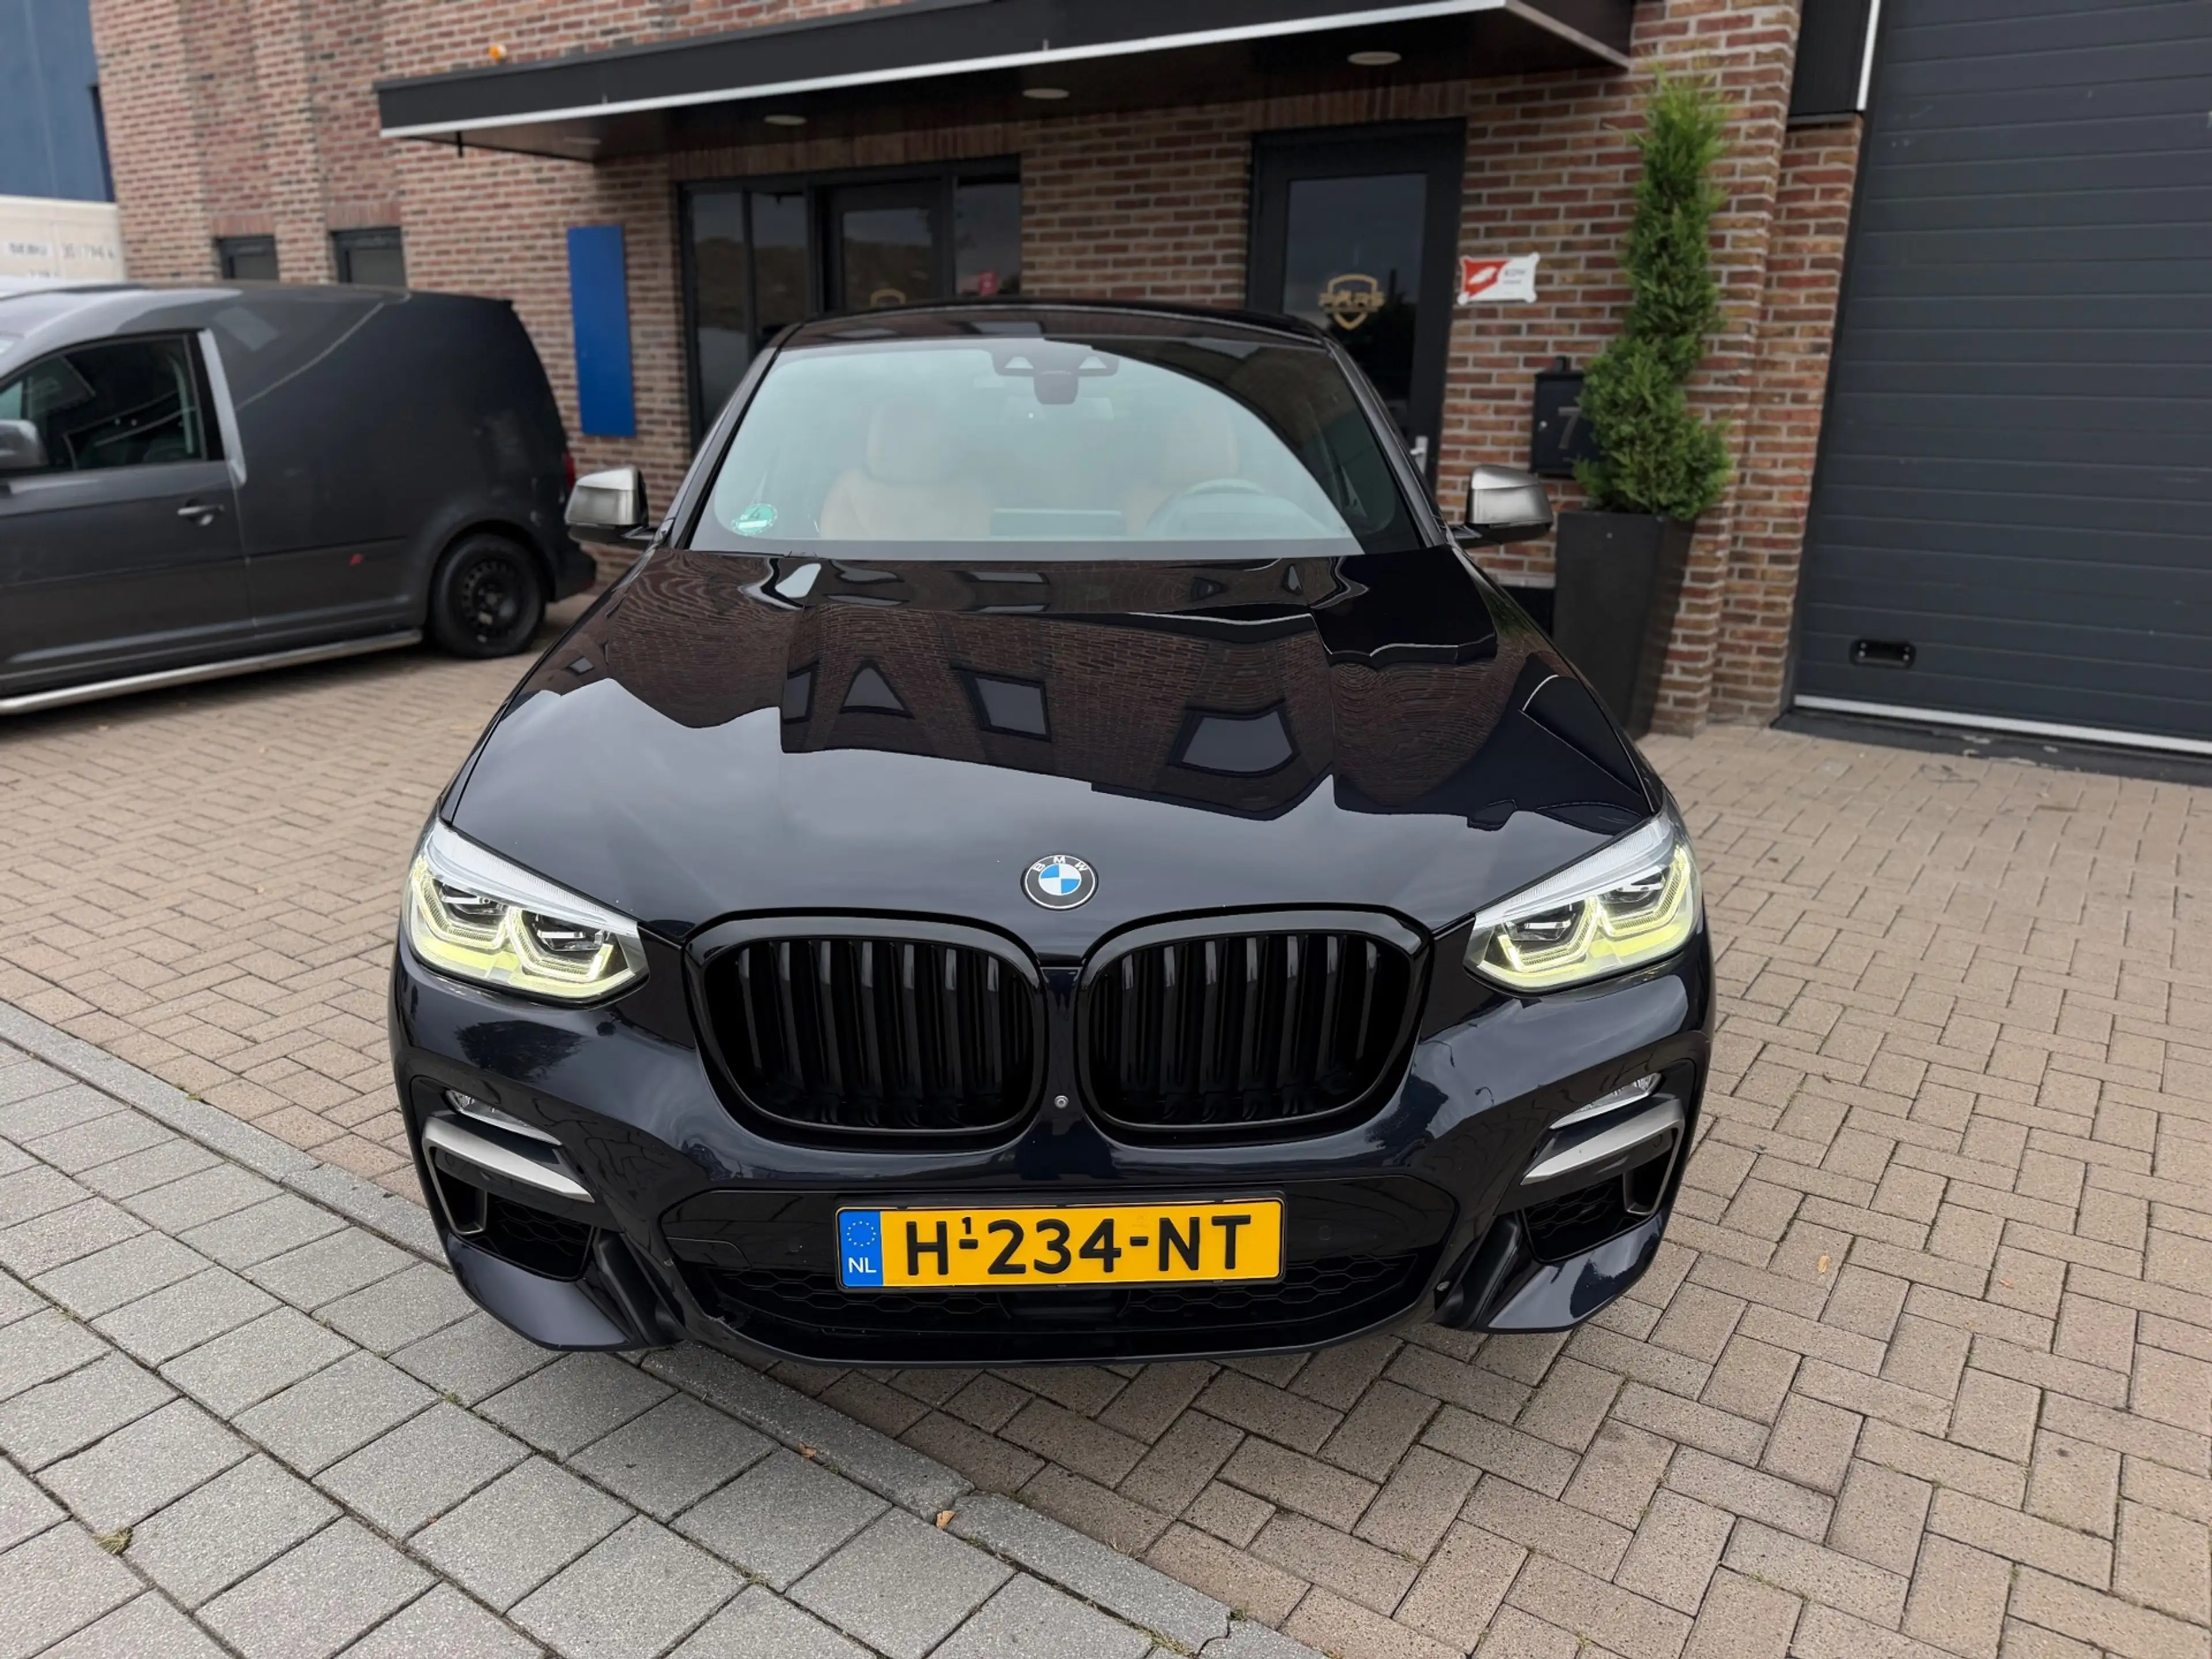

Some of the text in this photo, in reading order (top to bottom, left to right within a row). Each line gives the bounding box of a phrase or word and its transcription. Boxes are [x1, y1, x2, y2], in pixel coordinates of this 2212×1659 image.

[1557, 406, 1582, 450] 7
[1032, 855, 1089, 873] BMW
[848, 1256, 877, 1274] NL
